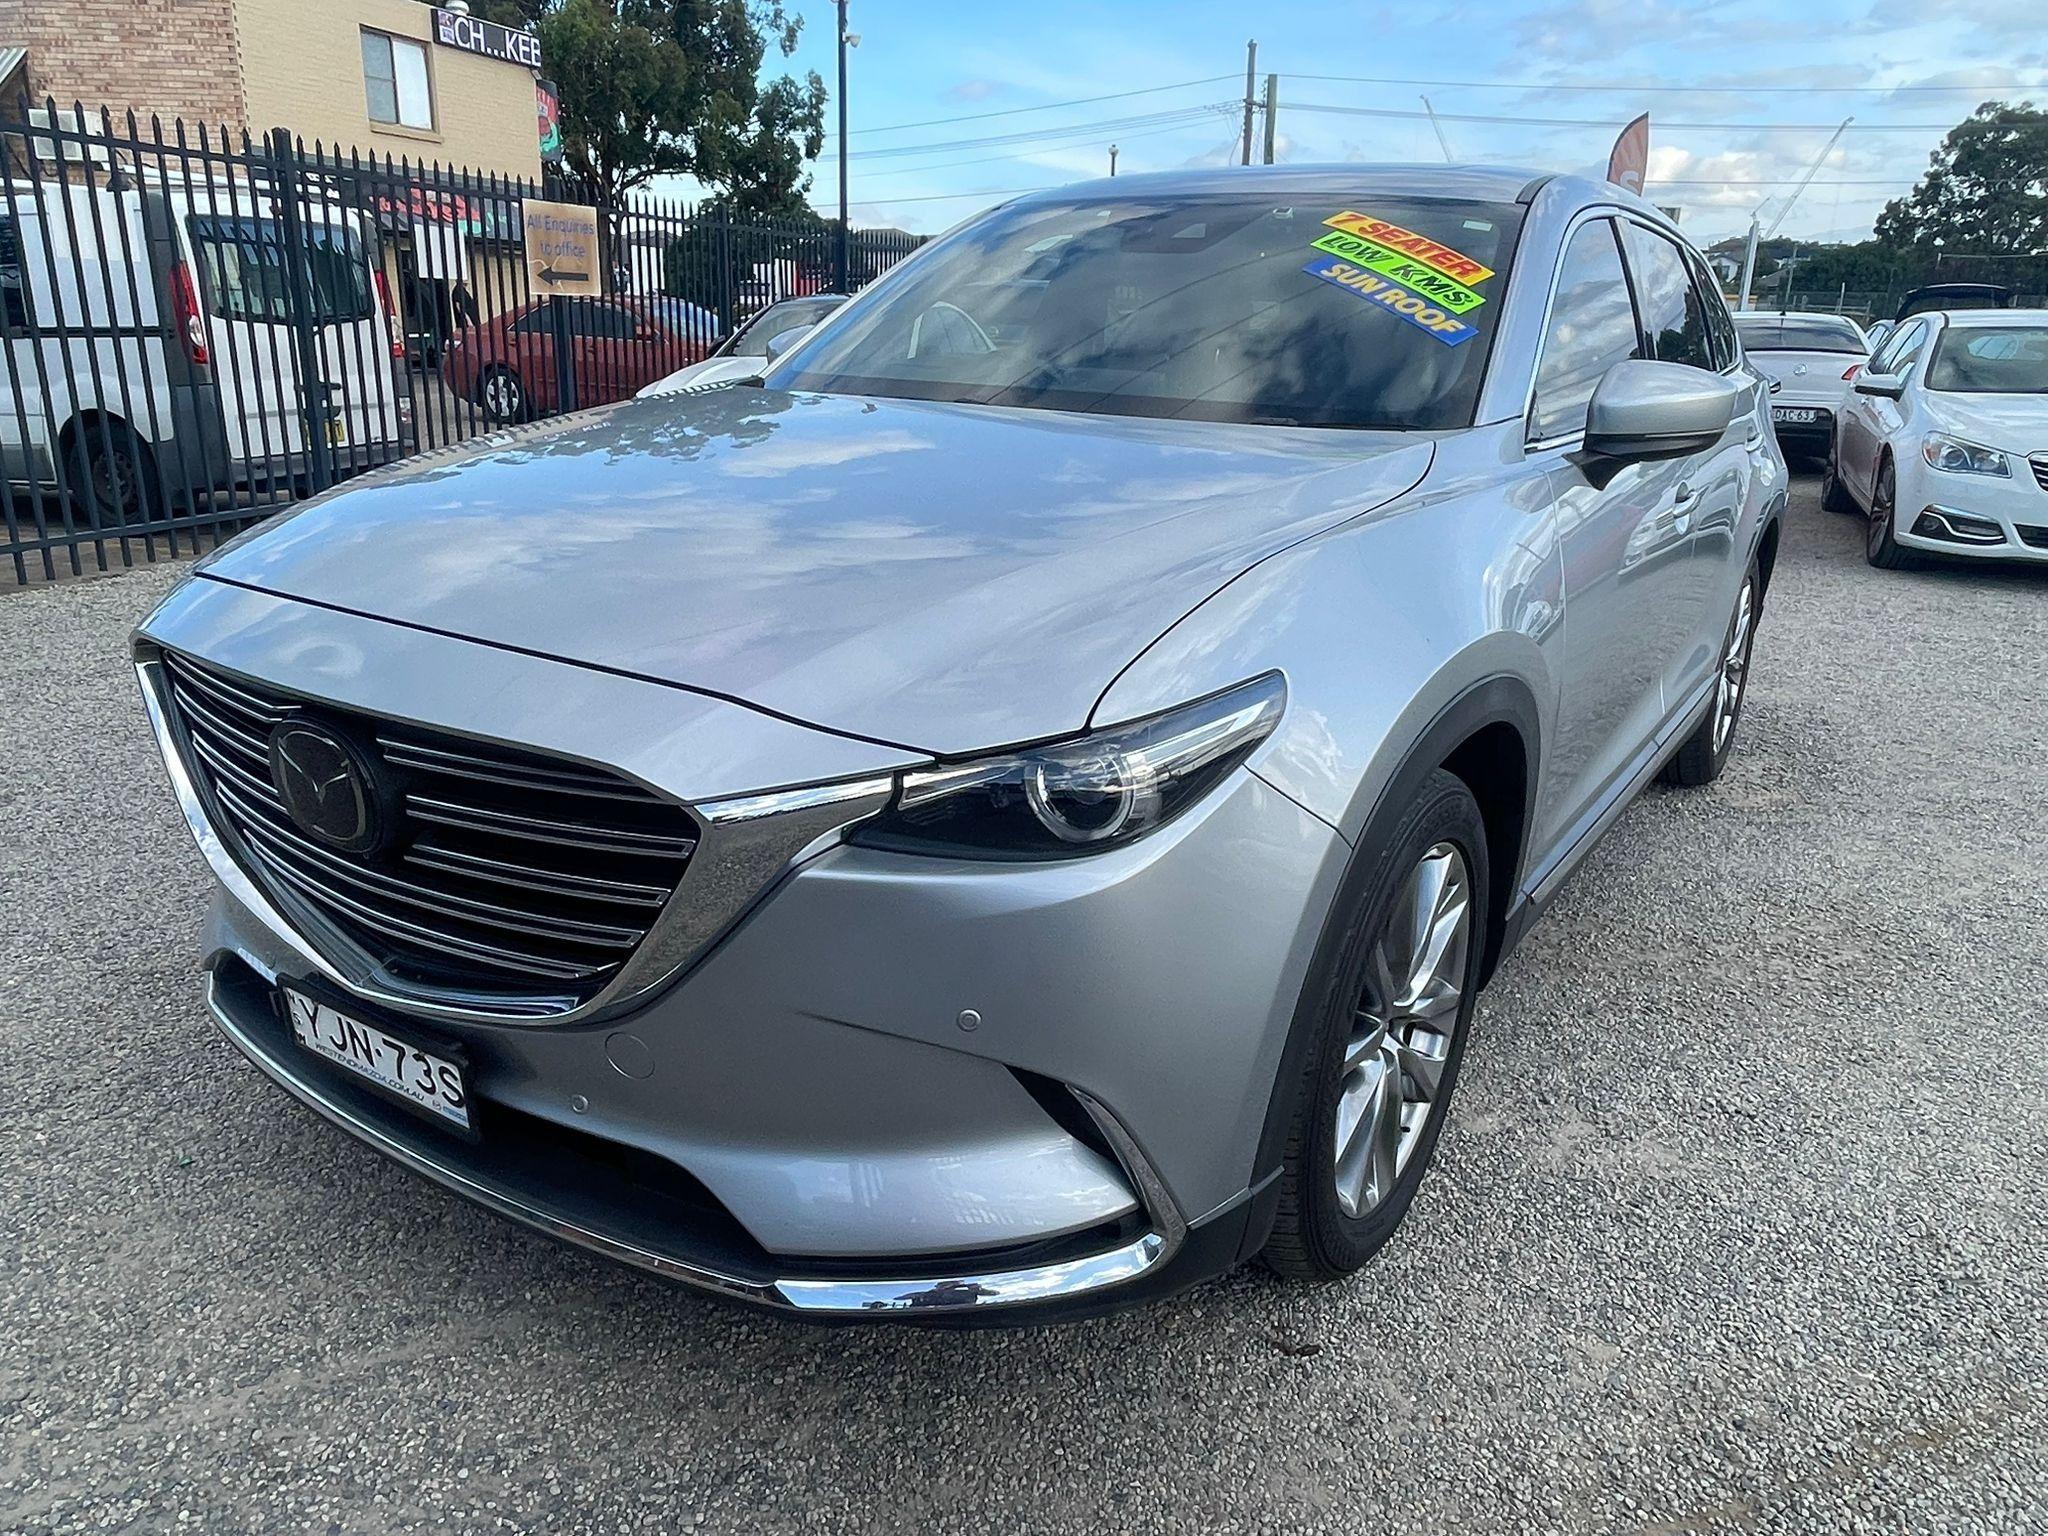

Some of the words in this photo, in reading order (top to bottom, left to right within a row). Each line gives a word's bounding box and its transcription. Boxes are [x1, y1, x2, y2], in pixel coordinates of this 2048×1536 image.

[527, 213, 542, 229] All
[544, 215, 595, 236] Enquiries
[540, 242, 553, 257] to
[554, 240, 586, 258] office
[1319, 235, 1395, 264] LOW
[1331, 214, 1366, 226] 7
[1358, 221, 1483, 279] SEATER
[1320, 263, 1388, 295] SUN
[1374, 288, 1467, 333] ROOF
